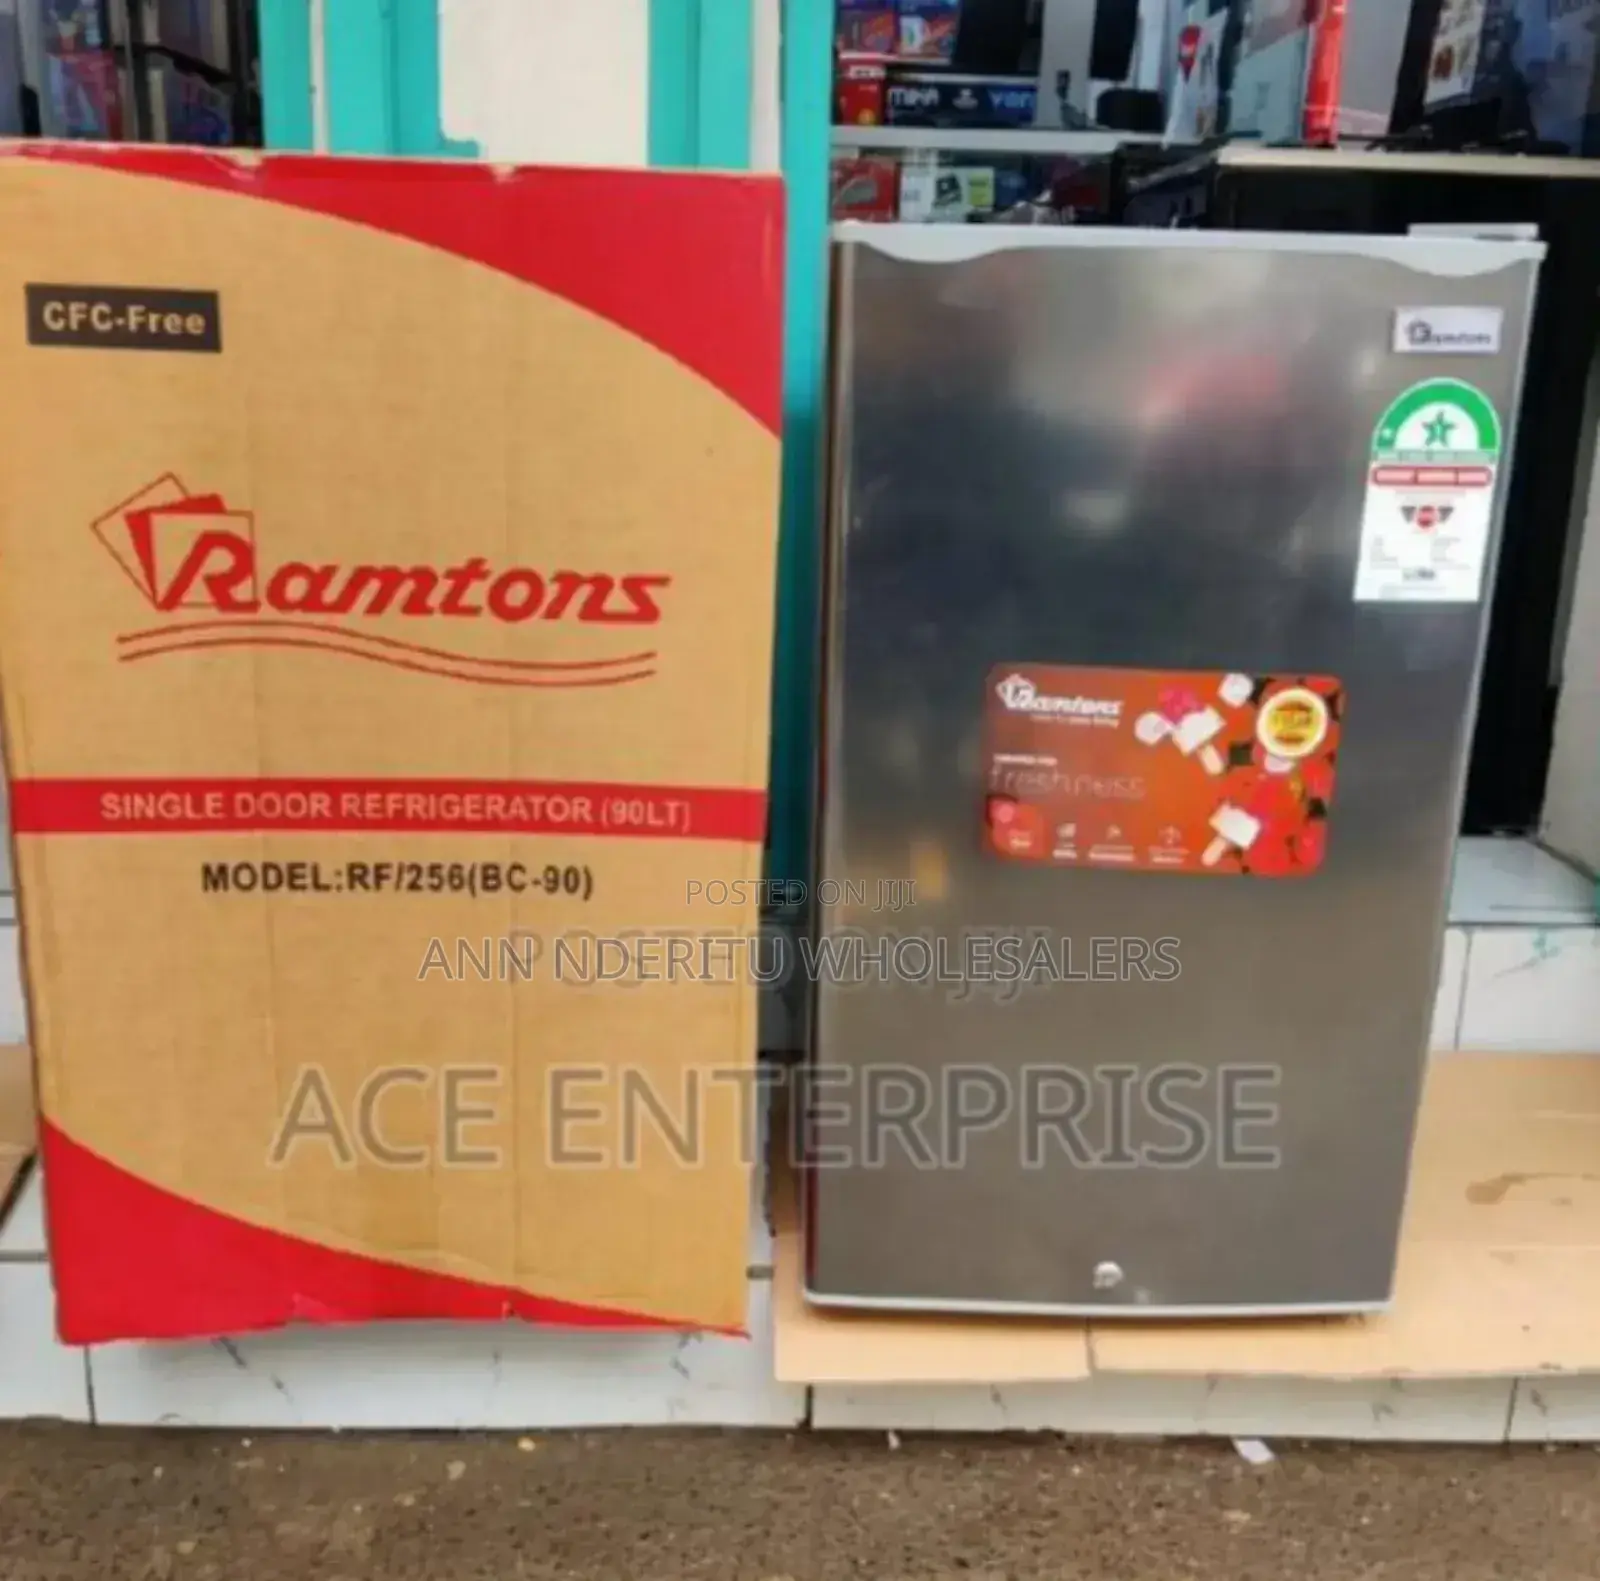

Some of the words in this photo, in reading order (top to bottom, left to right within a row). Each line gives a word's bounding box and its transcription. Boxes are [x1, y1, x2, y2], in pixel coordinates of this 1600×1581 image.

[42, 301, 206, 335] CFC-Free
[155, 529, 672, 624] Ramtons
[100, 791, 227, 820] SINGLE
[233, 791, 332, 819] DOOR
[340, 792, 593, 823] REFRIGERATOR
[201, 862, 593, 902] MODEL:RF/256(BC-90)
